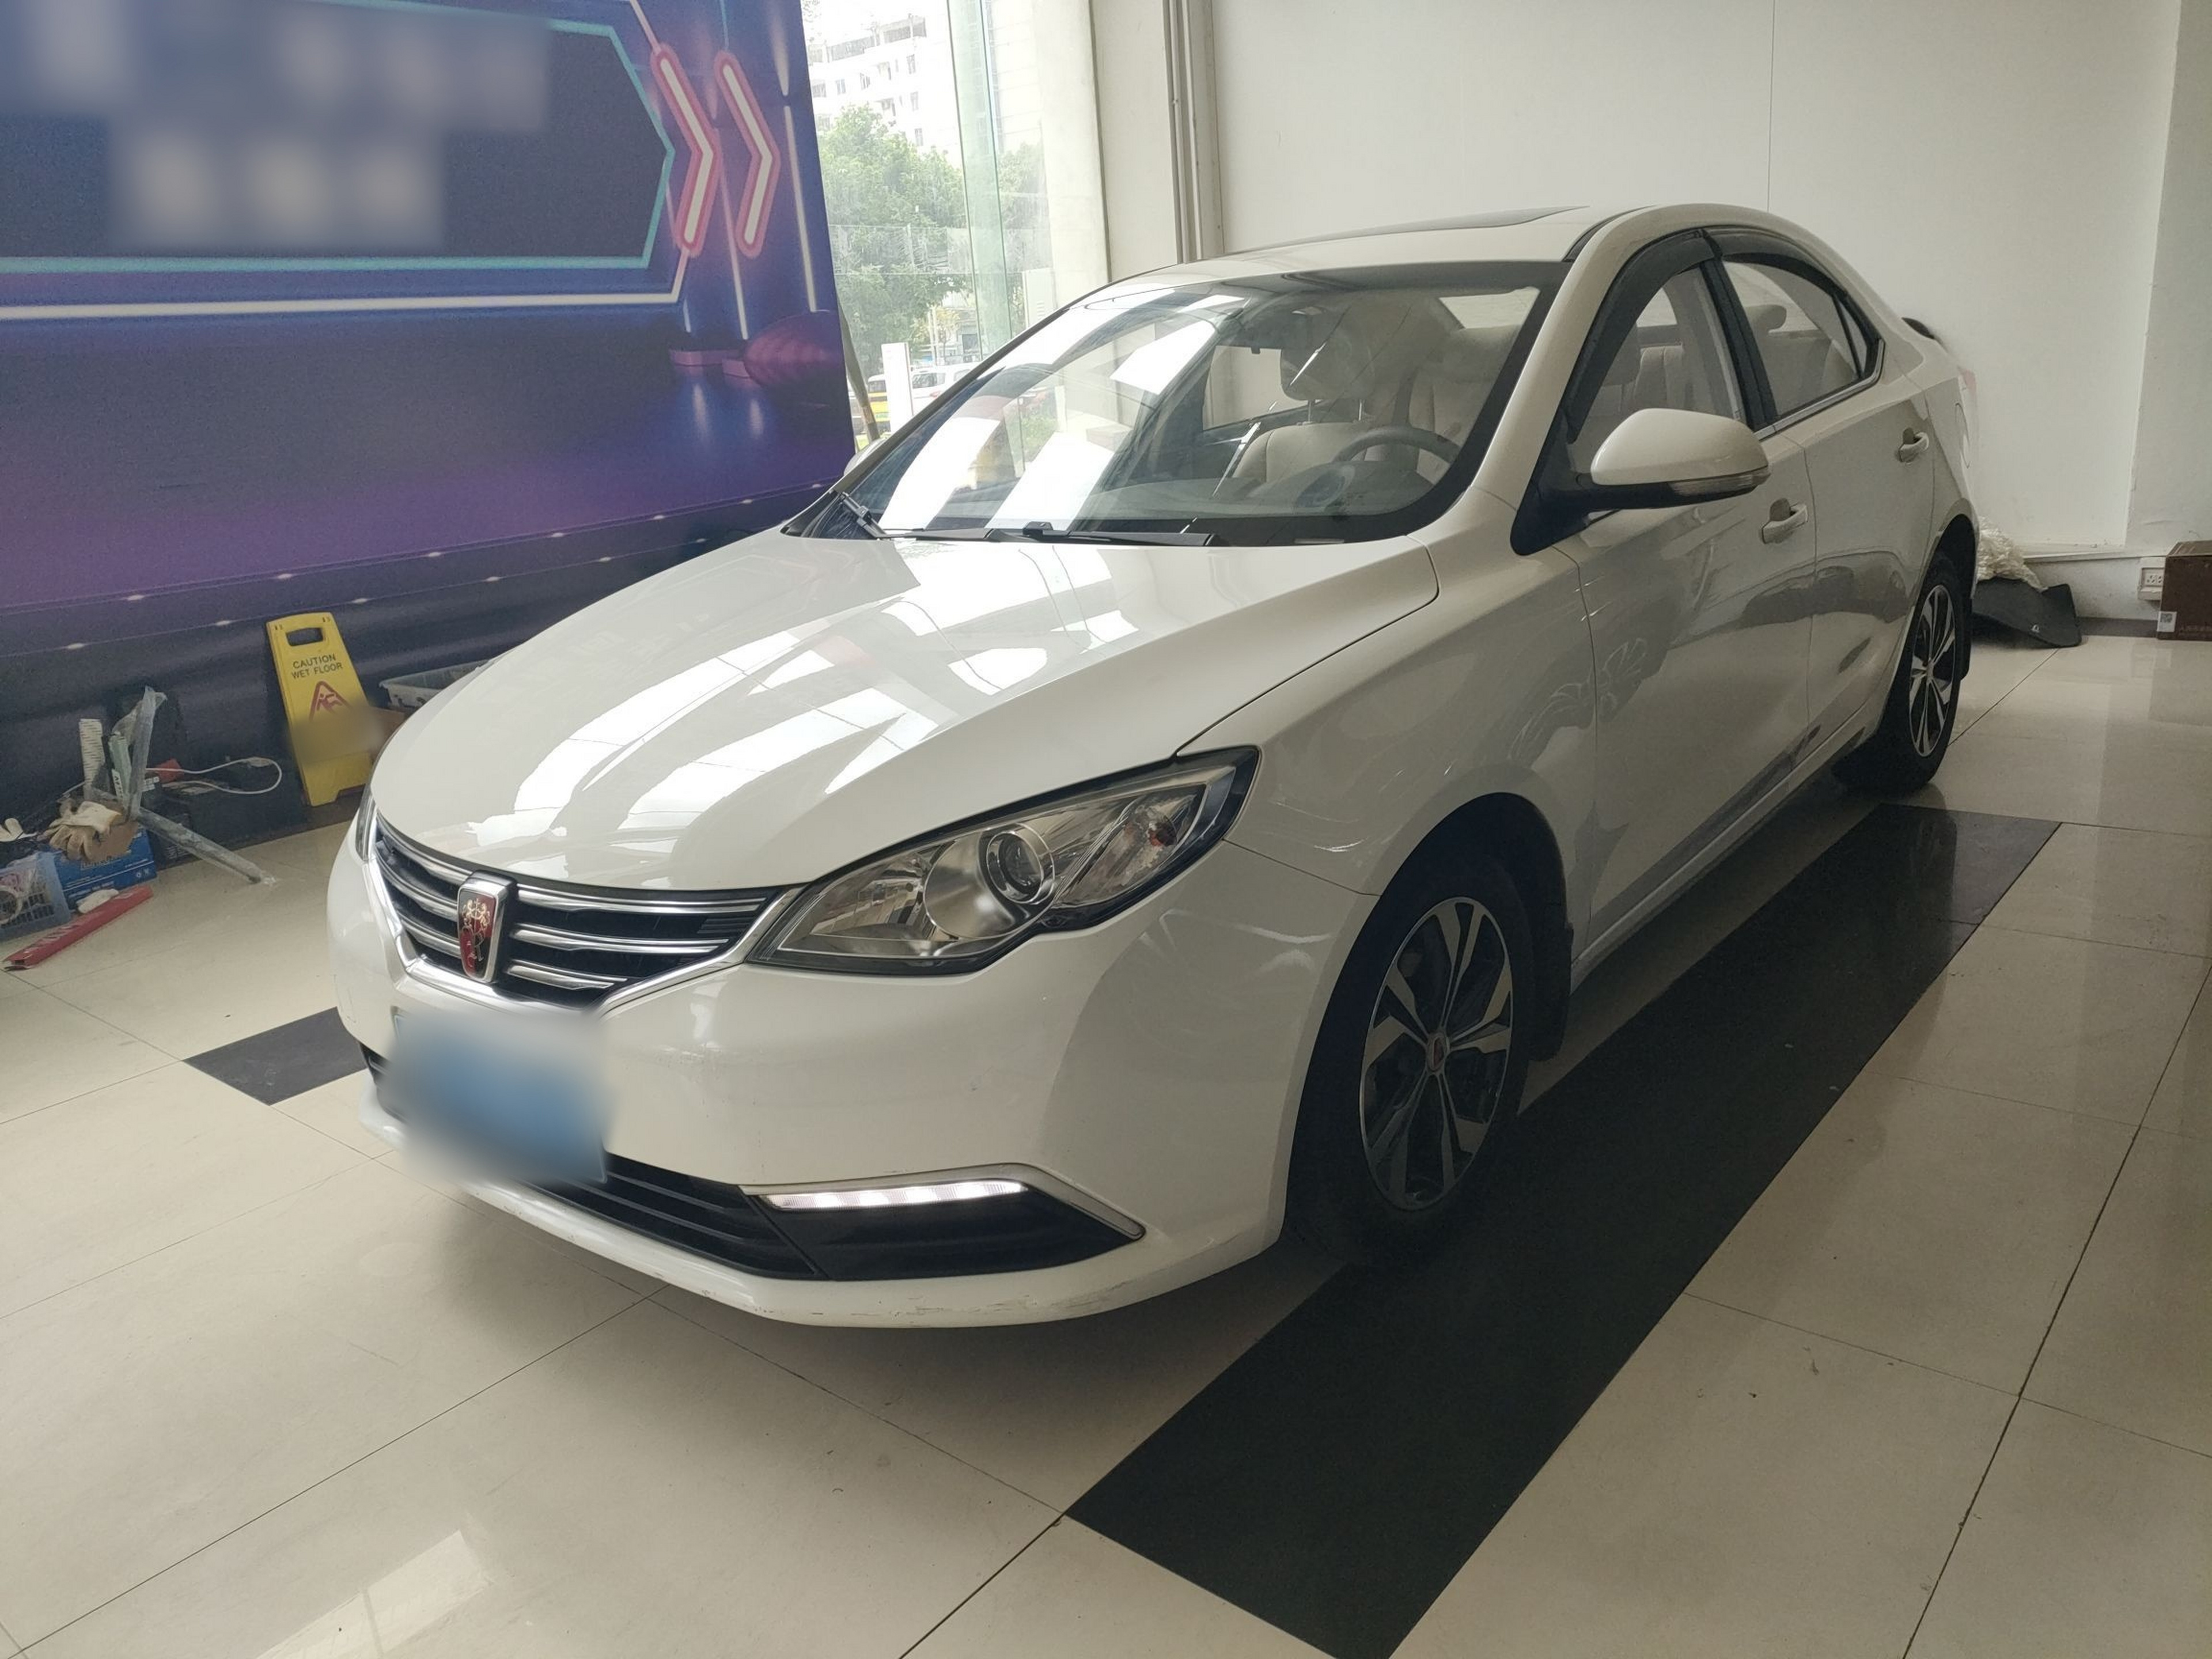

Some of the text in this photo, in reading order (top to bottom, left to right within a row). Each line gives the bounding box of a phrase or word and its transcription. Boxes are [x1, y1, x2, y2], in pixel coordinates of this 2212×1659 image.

[293, 653, 336, 669] CAUTION
[291, 662, 343, 679] WET FLOOR
